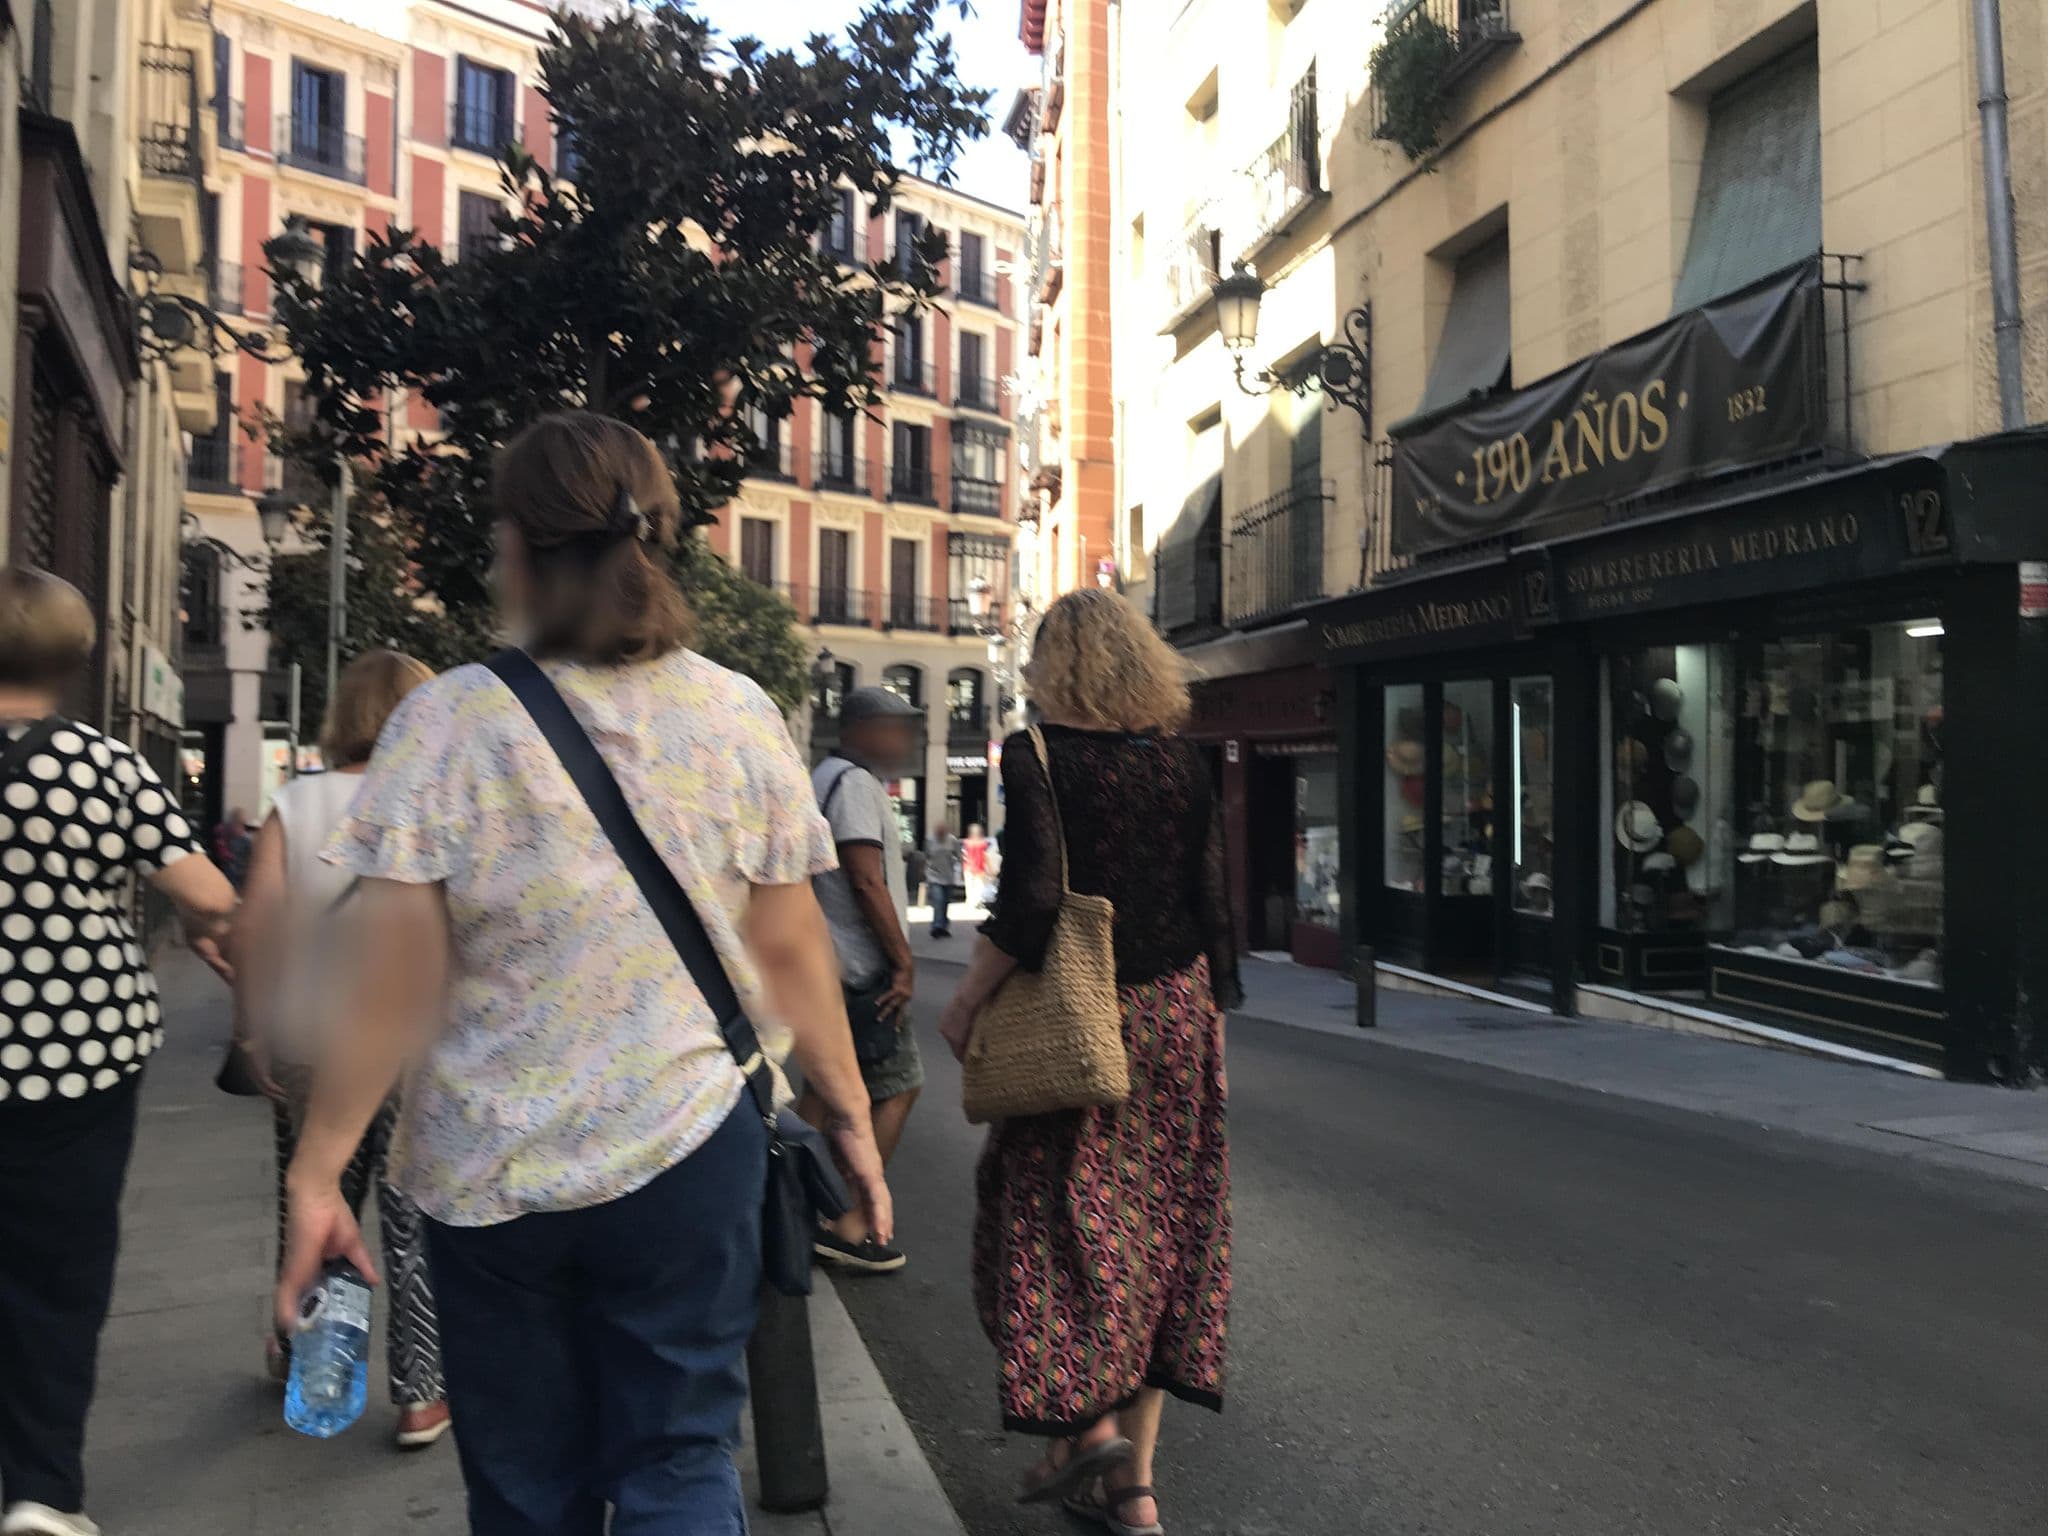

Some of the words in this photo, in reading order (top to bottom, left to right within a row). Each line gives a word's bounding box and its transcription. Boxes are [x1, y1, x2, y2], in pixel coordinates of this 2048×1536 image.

[1472, 432, 1532, 505] 190
[1540, 378, 1670, 486] AÑOS
[1730, 511, 1861, 564] MEDRANO
[1900, 489, 1949, 555] 12
